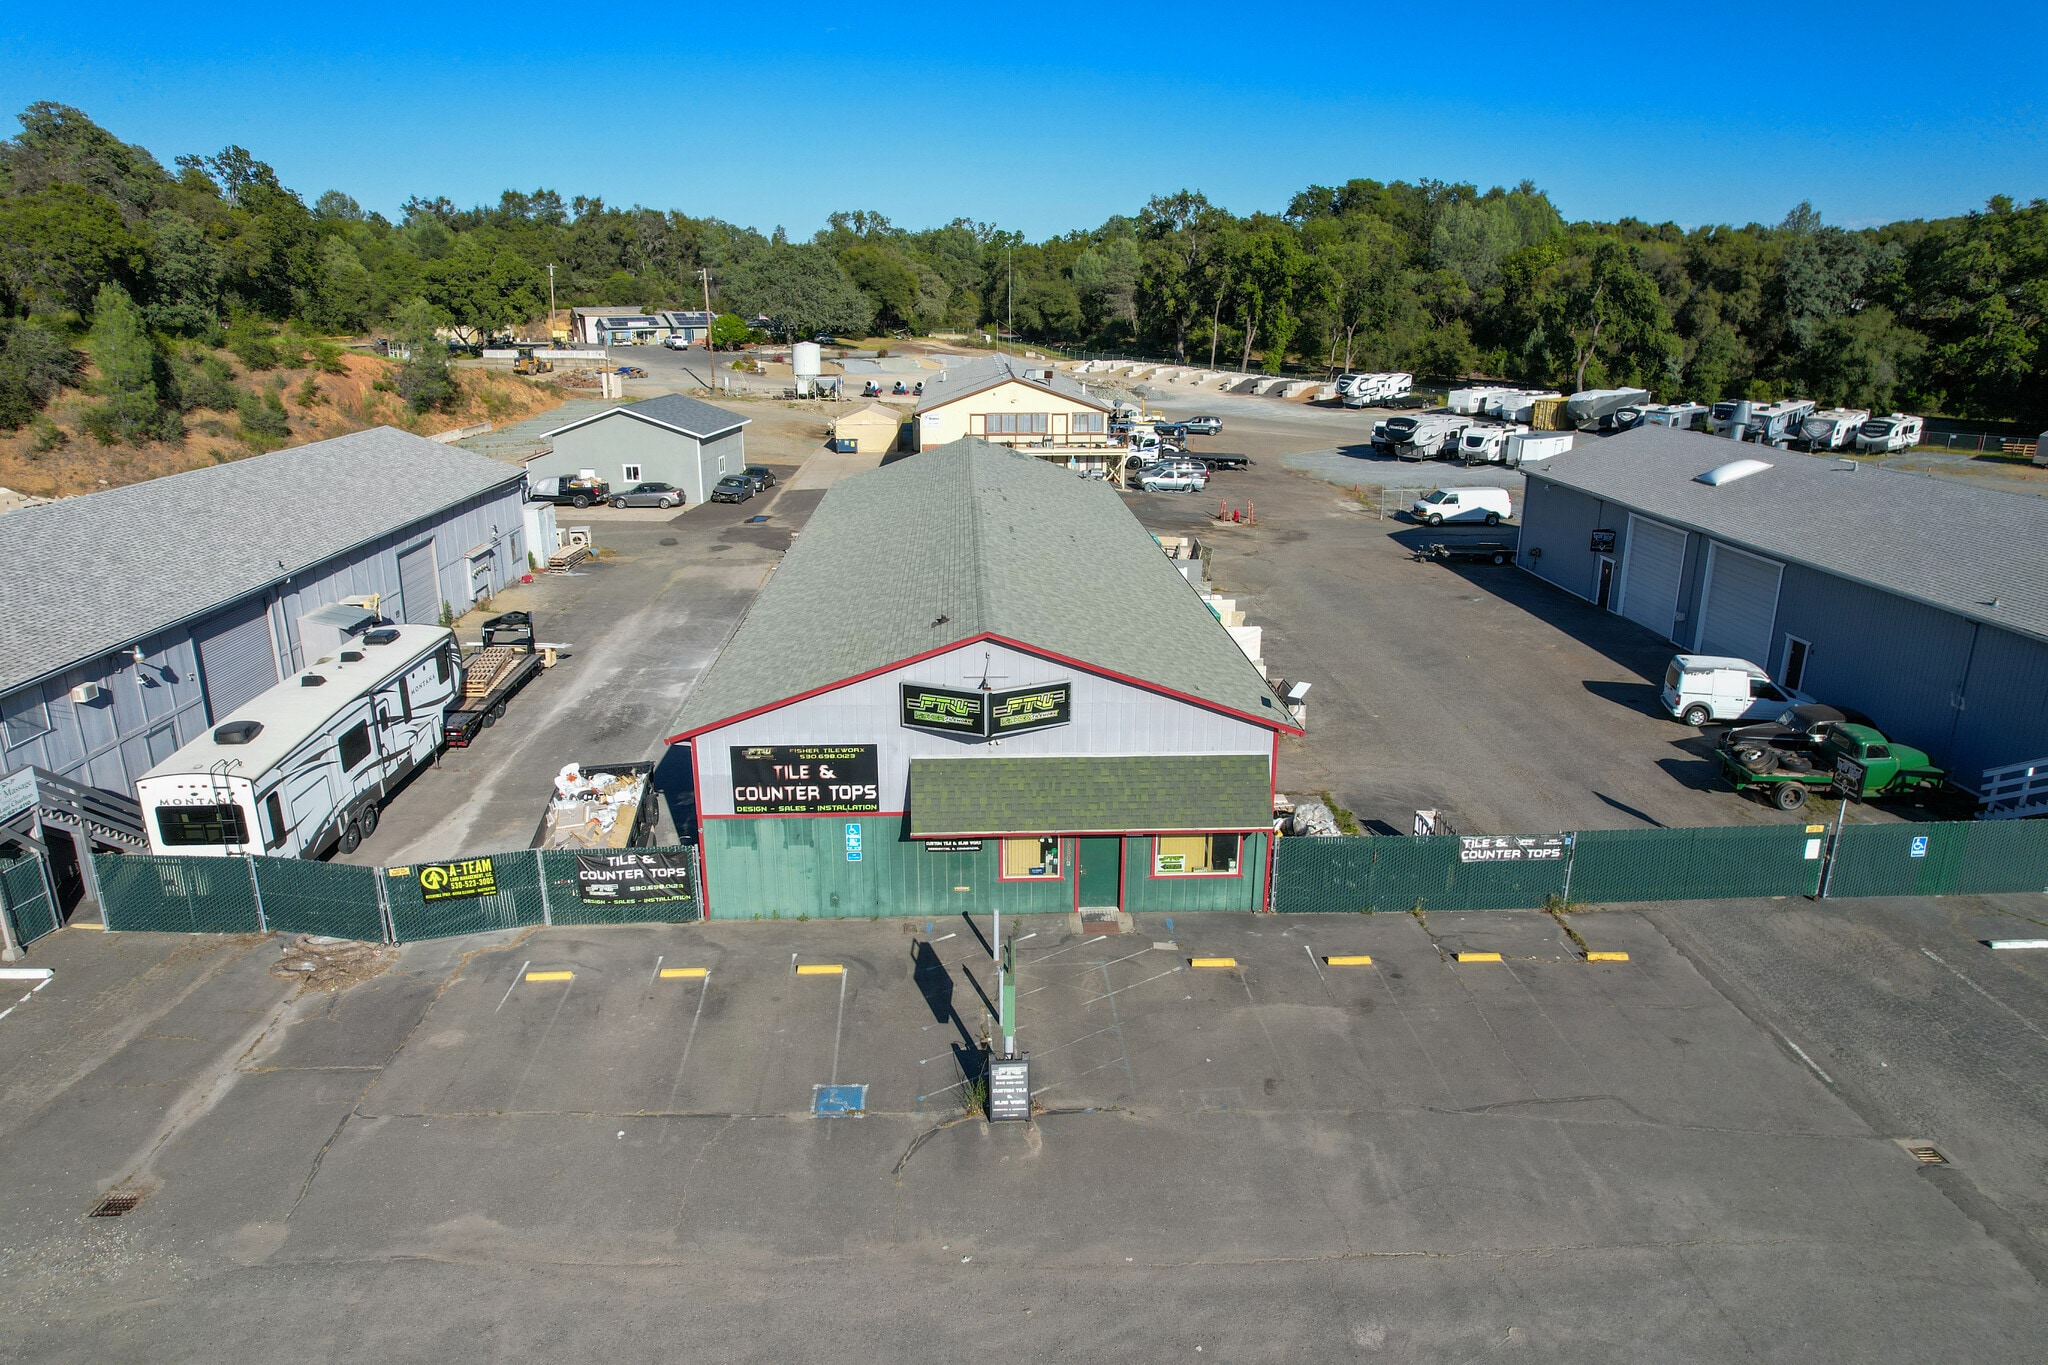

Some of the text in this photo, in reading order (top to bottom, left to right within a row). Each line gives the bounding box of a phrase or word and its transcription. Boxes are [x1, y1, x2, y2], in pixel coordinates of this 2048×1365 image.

[411, 674, 435, 695] MONTANA
[772, 763, 838, 780] TILE &
[735, 784, 877, 802] COUNTER TOPS
[160, 798, 238, 806] MONTANA
[1462, 838, 1491, 849] TILE
[1496, 839, 1508, 848] &
[1461, 848, 1561, 860] COUNTER TOPS
[449, 858, 492, 876] A-TEAM
[607, 855, 656, 867] TILE &
[579, 868, 686, 881] COUNTER TOPS
[450, 877, 494, 889] 530-523-3005
[644, 895, 691, 903] INSTALLATION
